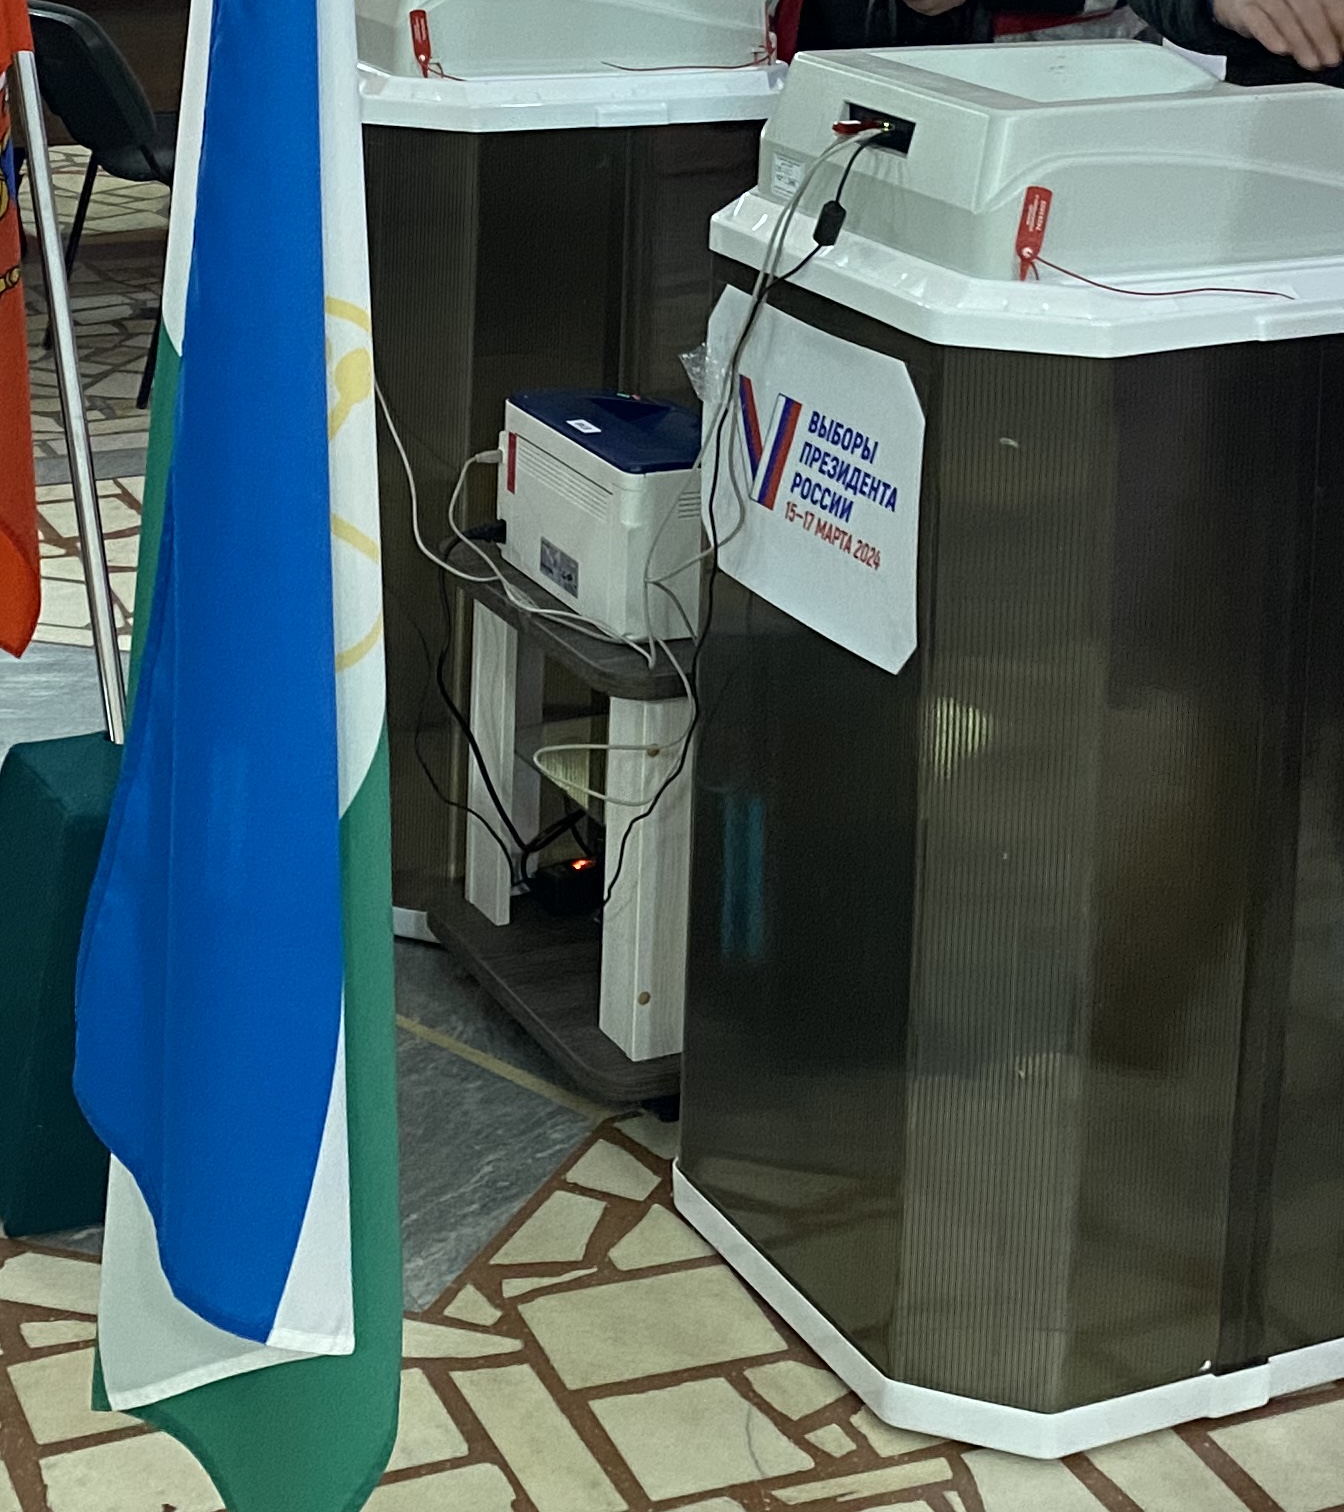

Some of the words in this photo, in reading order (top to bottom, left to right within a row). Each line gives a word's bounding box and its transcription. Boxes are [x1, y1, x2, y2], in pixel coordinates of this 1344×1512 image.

[807, 410, 879, 464] ВЫБОРЫ
[790, 472, 854, 523] РОССИИ
[799, 441, 898, 513] ПРЕЗИДЕНТА
[814, 518, 853, 555] МАРТА
[853, 539, 881, 571] 2024
